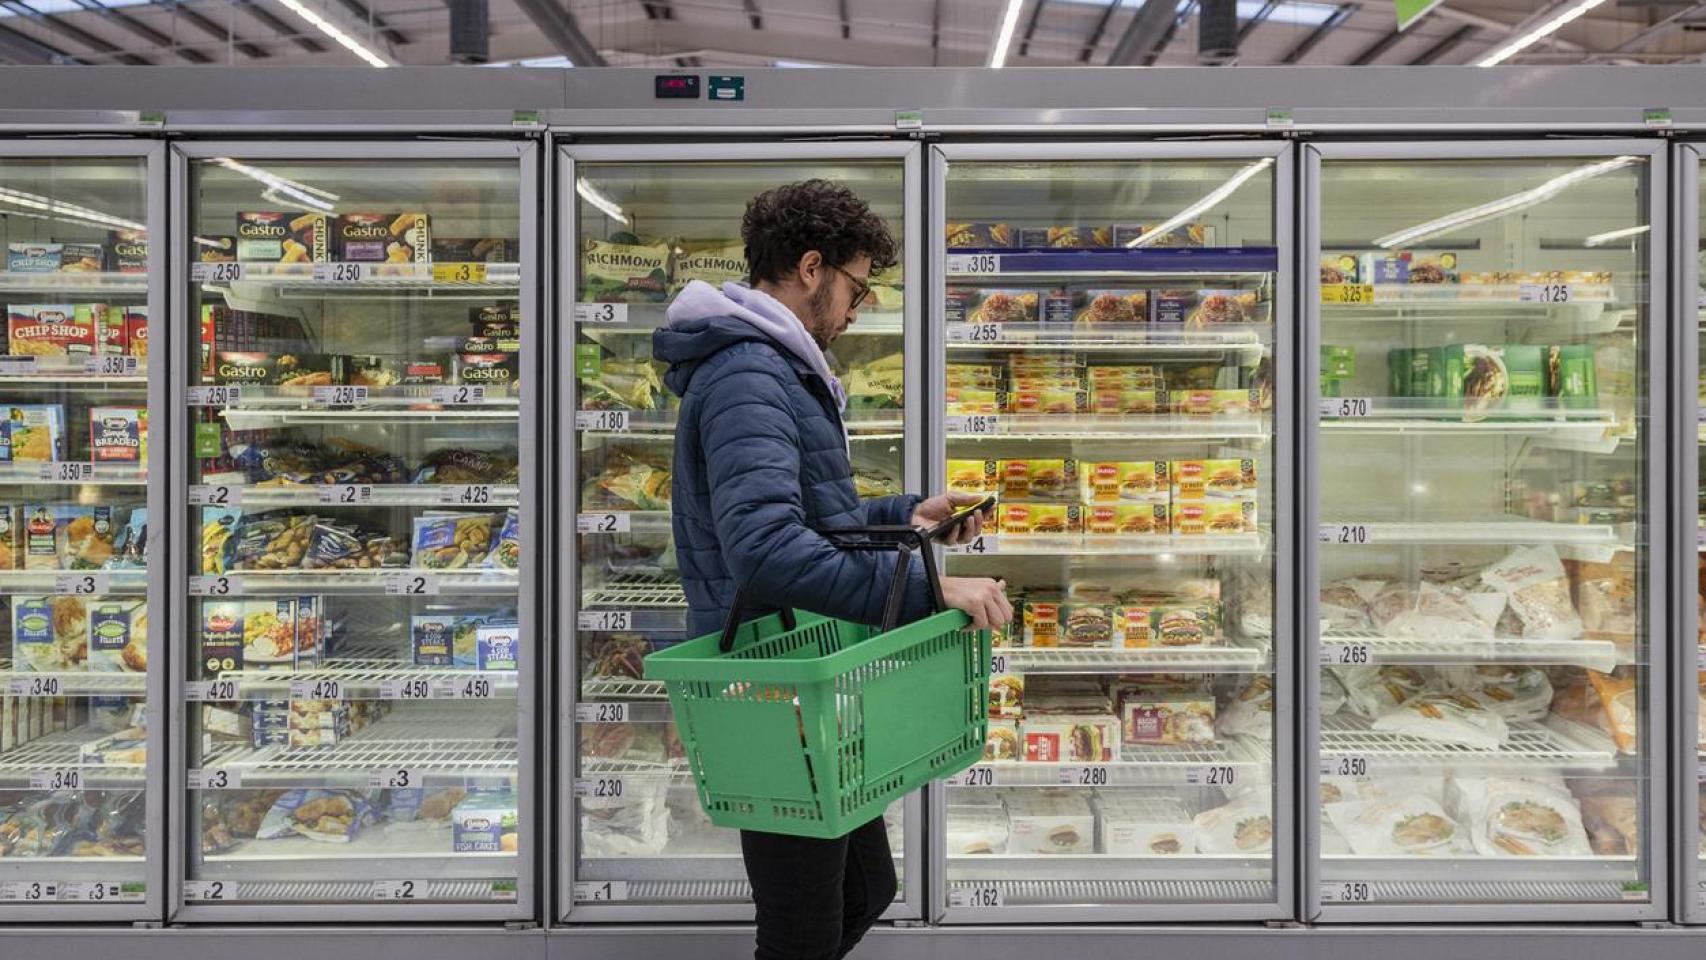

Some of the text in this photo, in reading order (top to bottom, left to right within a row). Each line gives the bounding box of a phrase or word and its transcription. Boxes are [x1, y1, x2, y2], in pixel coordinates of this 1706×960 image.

[240, 223, 285, 237] Gastro
[343, 224, 387, 238] Gastro
[314, 217, 325, 262] CHUNK
[415, 218, 425, 262] CHUNK
[587, 252, 662, 269] RICHMOND
[456, 265, 470, 281] £3
[595, 304, 614, 322] £3
[15, 325, 50, 339] CHIP
[51, 324, 88, 338] SHOP
[465, 342, 494, 351] Gastro
[219, 364, 266, 378] Gastro
[462, 367, 510, 380] Gastro
[453, 387, 468, 403] £2
[94, 436, 138, 447] BREADED
[208, 486, 229, 503] £2
[340, 486, 356, 503] £2
[598, 514, 617, 532] £2
[966, 536, 985, 553] £4
[75, 577, 96, 594] £3
[210, 577, 229, 595] £3
[406, 577, 425, 594] £2
[208, 770, 228, 788] £3
[390, 769, 409, 787] £3
[25, 883, 41, 900] £3
[89, 883, 104, 900] £3
[203, 882, 223, 900] £2
[395, 881, 414, 898] £2
[594, 882, 611, 900] £1
